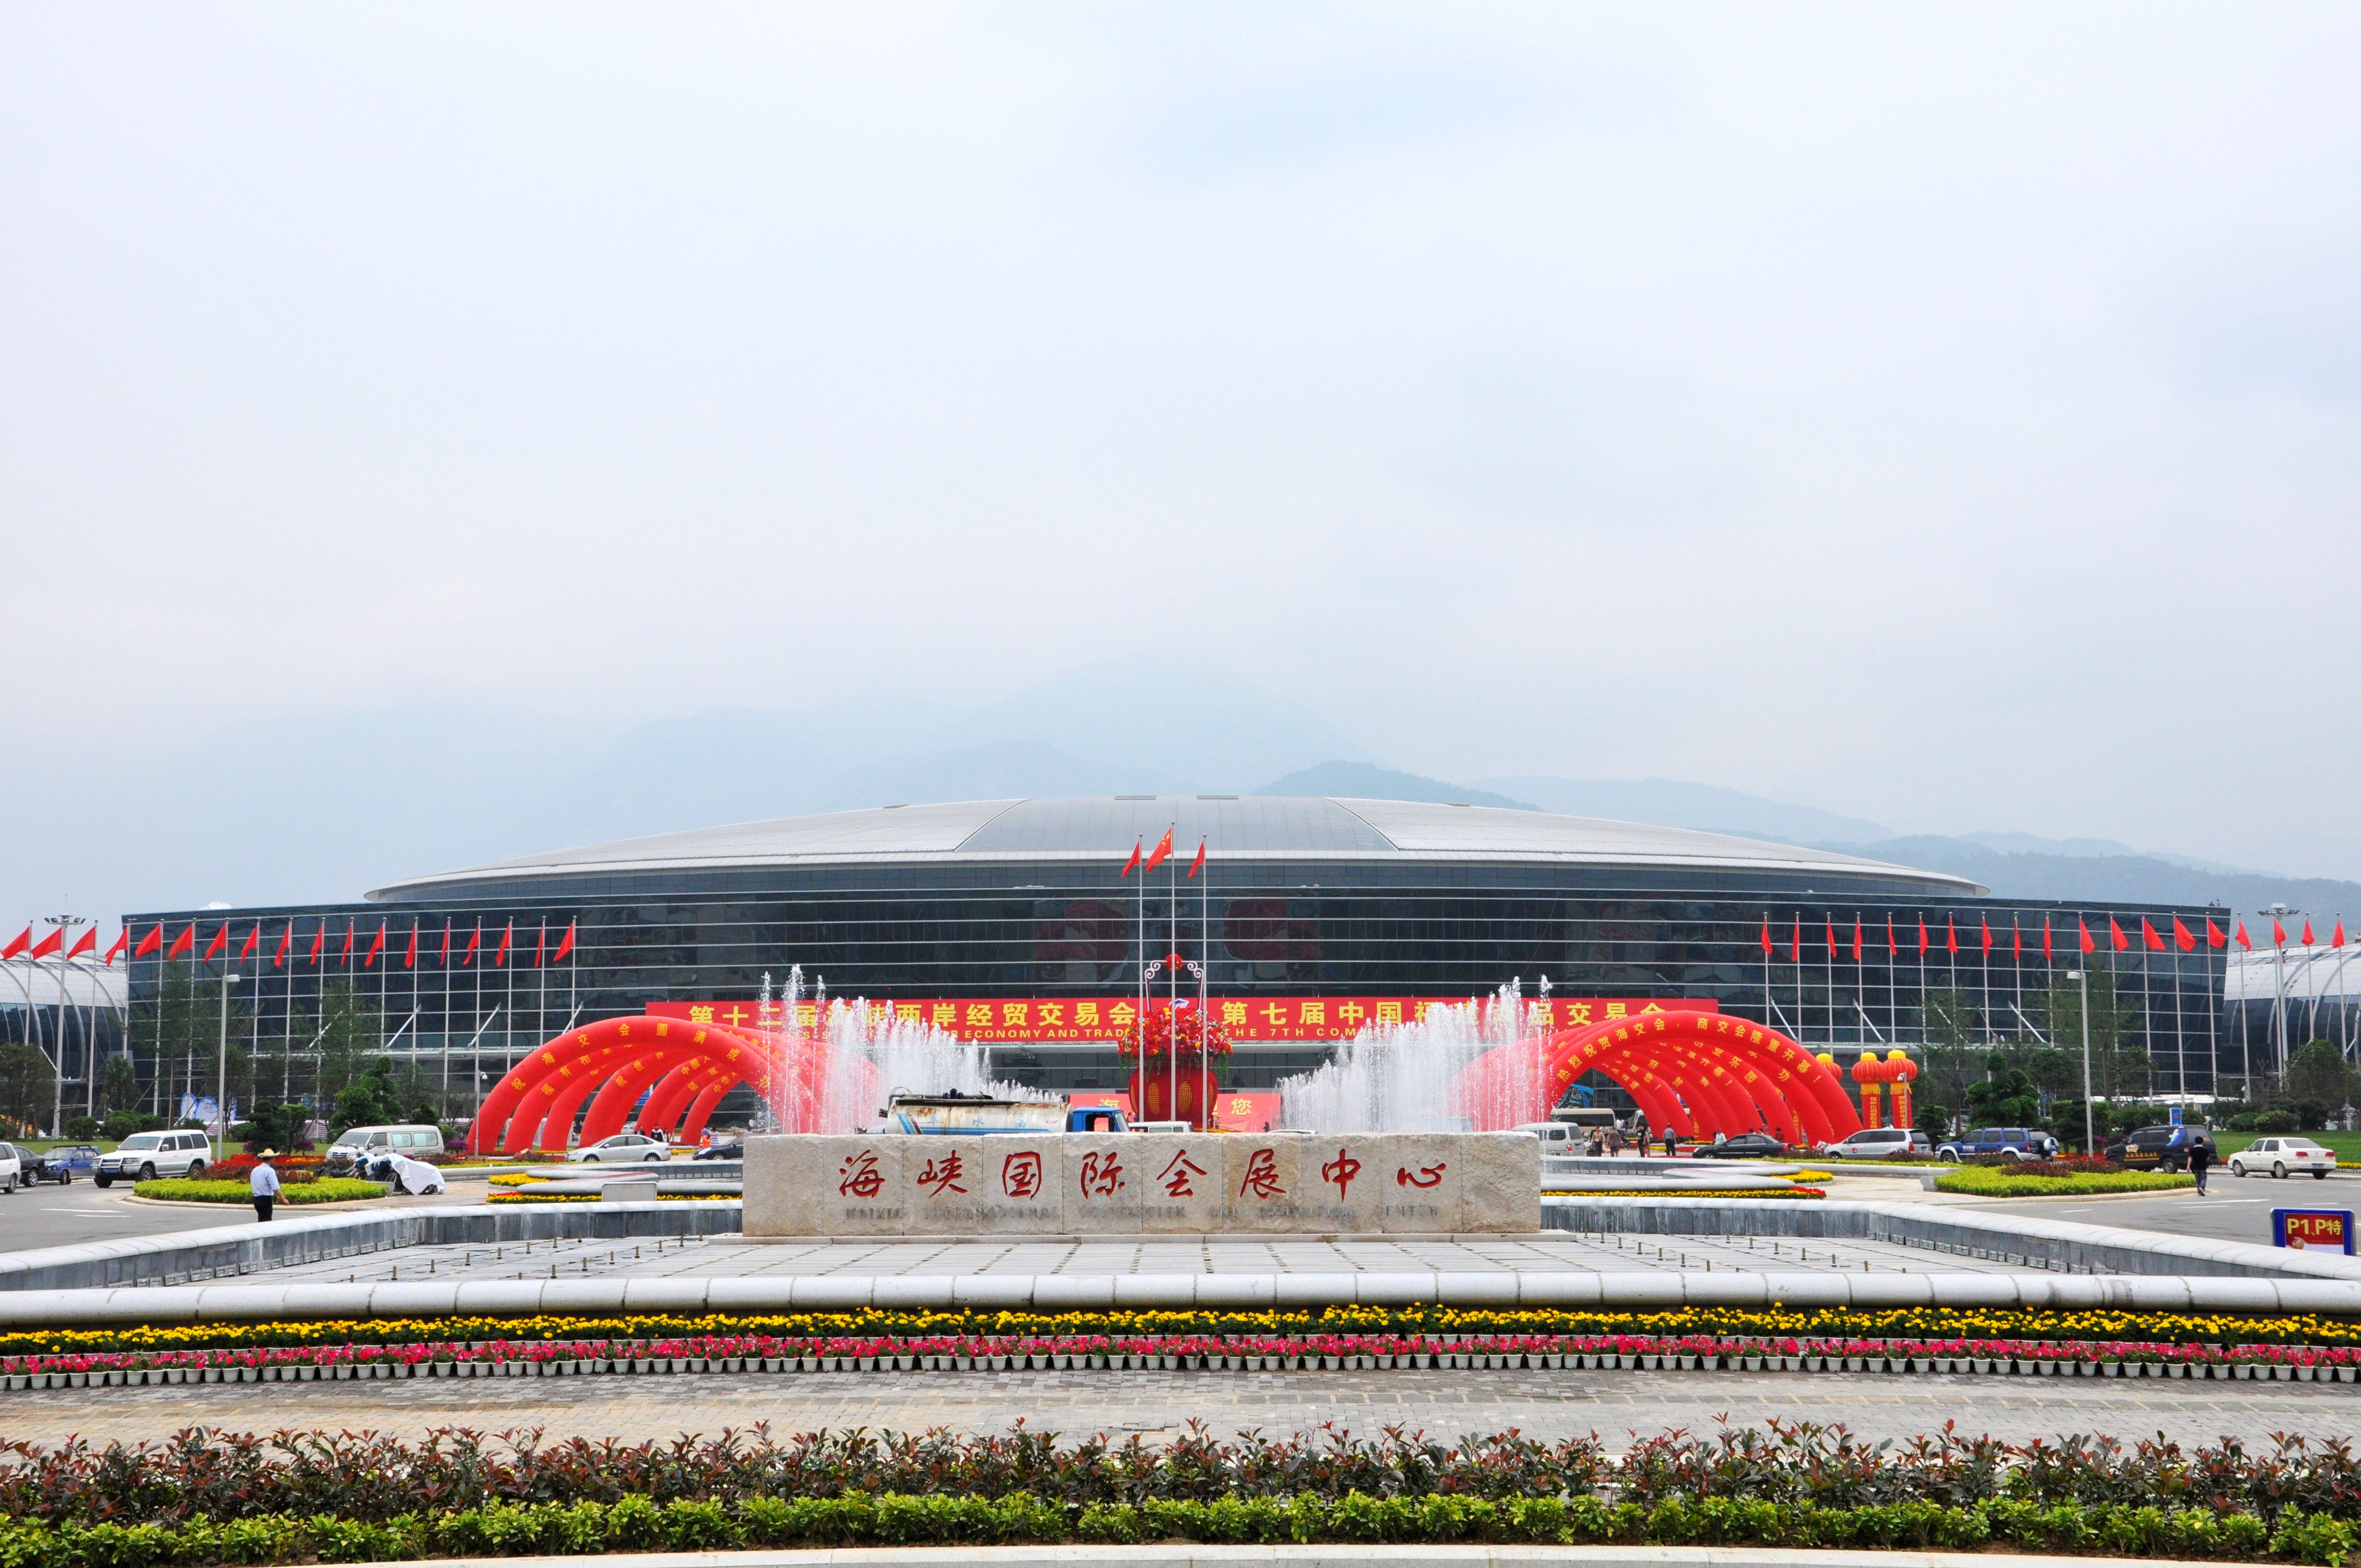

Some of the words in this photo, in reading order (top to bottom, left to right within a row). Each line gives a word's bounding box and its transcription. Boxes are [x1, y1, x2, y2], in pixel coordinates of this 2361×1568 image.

[965, 1030, 1041, 1038] ECONOMY
[1047, 1029, 1079, 1037] AND
[1084, 1028, 1124, 1037] TRAD
[1270, 1028, 1304, 1037] 7TH
[839, 1148, 1447, 1203] 海峡国际会展中心
